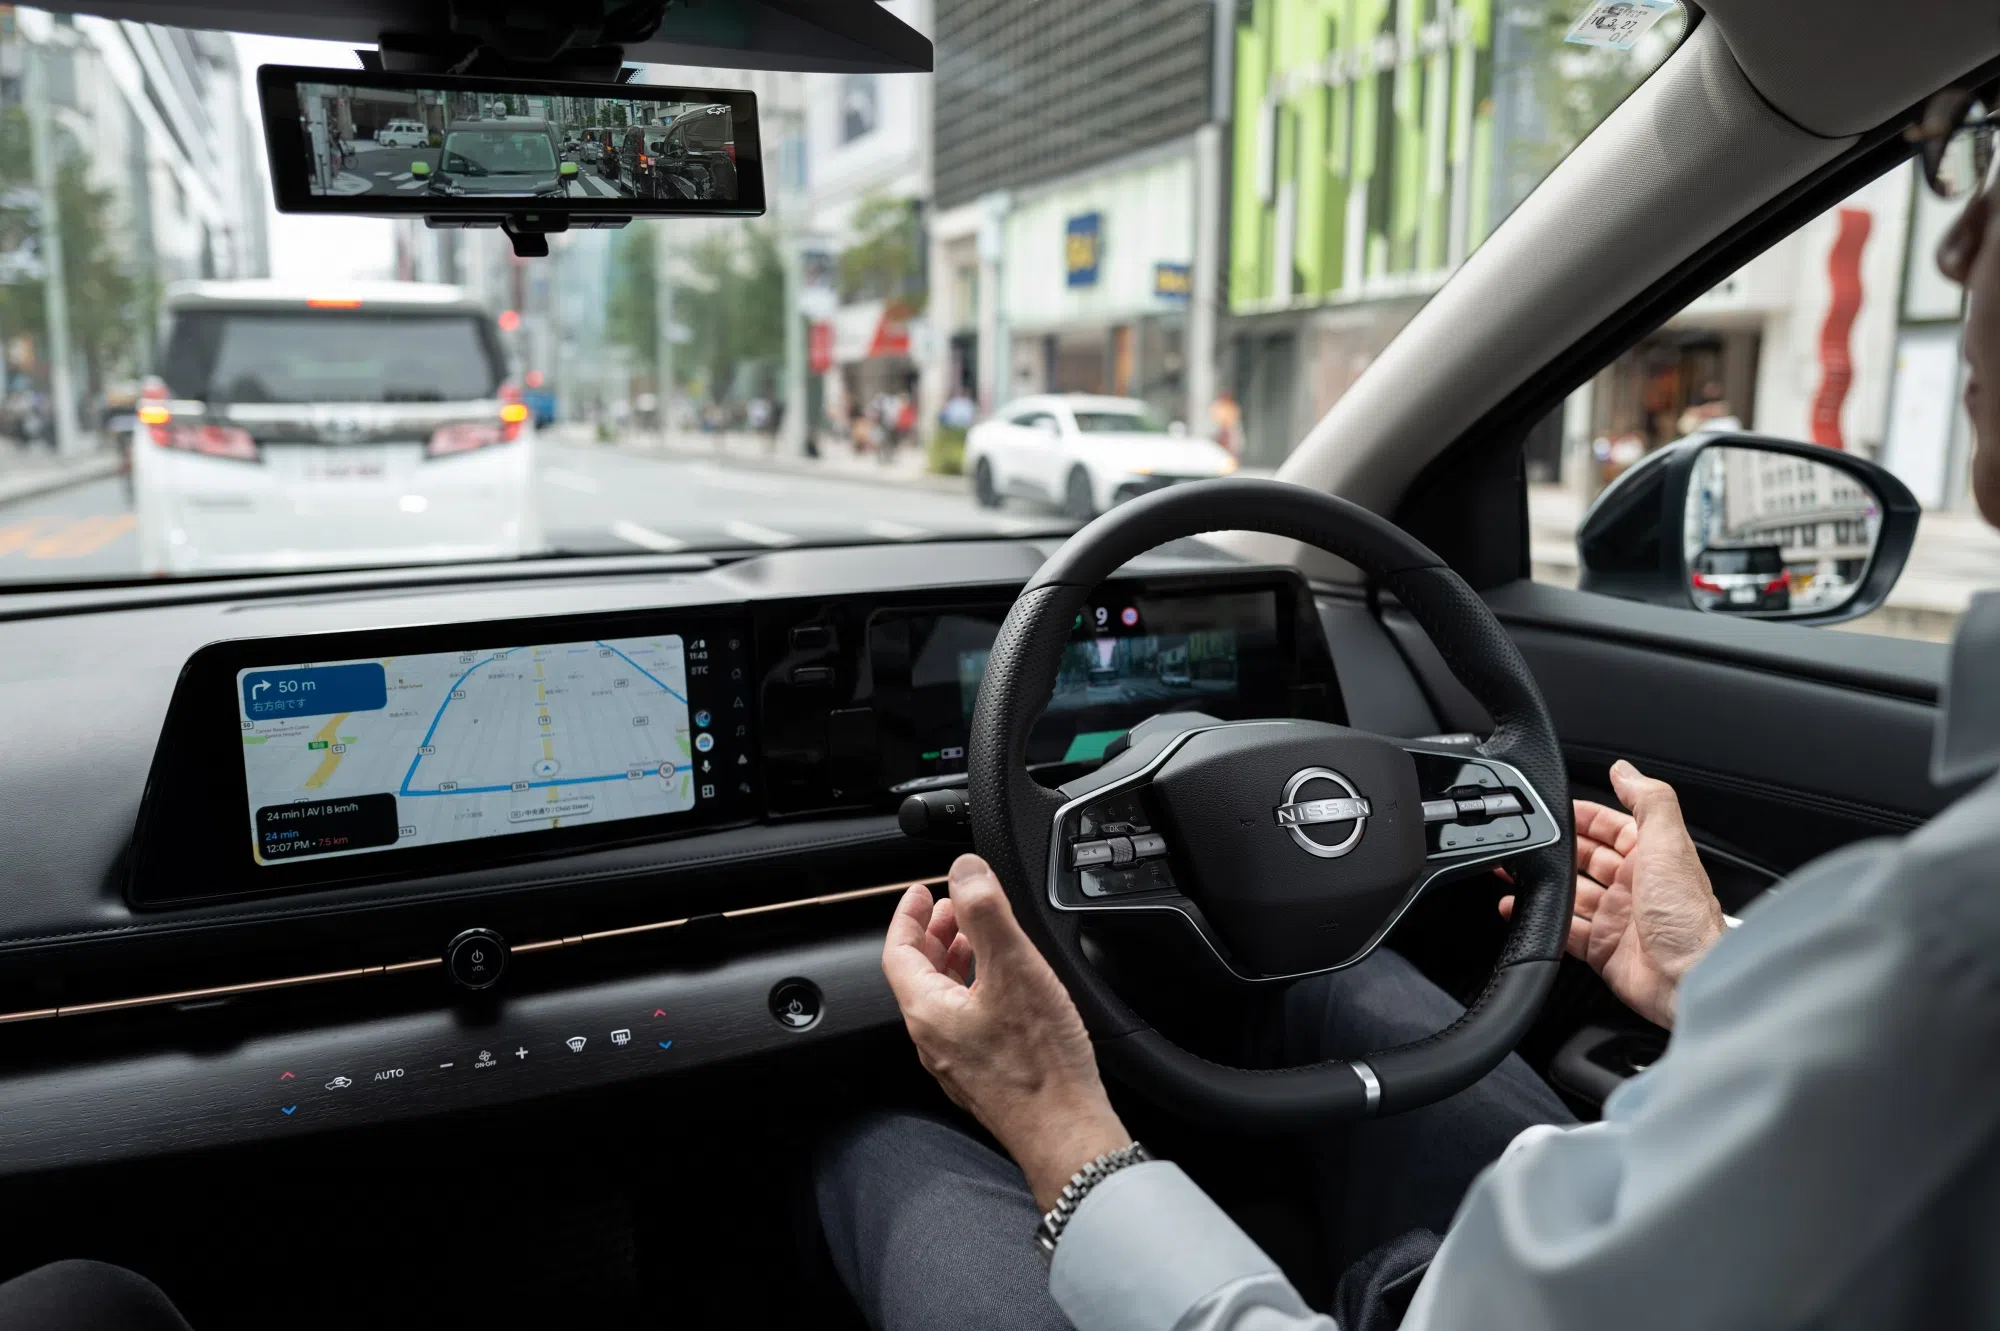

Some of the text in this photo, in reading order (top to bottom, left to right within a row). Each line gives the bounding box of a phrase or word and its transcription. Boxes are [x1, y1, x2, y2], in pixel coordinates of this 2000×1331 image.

[445, 186, 465, 195] Menu
[1095, 606, 1108, 626] 9
[689, 651, 708, 660] 11:43
[279, 680, 316, 693] 50 m
[252, 698, 307, 712] 右方向です
[1459, 801, 1483, 809] CANCEL
[267, 812, 280, 822] 24
[281, 809, 300, 819] min
[307, 807, 319, 817] AV
[326, 805, 333, 815] 8
[334, 803, 359, 813] km/h
[1277, 800, 1370, 824] NISSAN
[265, 830, 299, 841] 24 min
[1109, 825, 1120, 833] OK
[266, 843, 292, 854] 12:07
[294, 840, 310, 850] PM
[333, 836, 349, 846] km
[374, 1068, 405, 1082] AUTO
